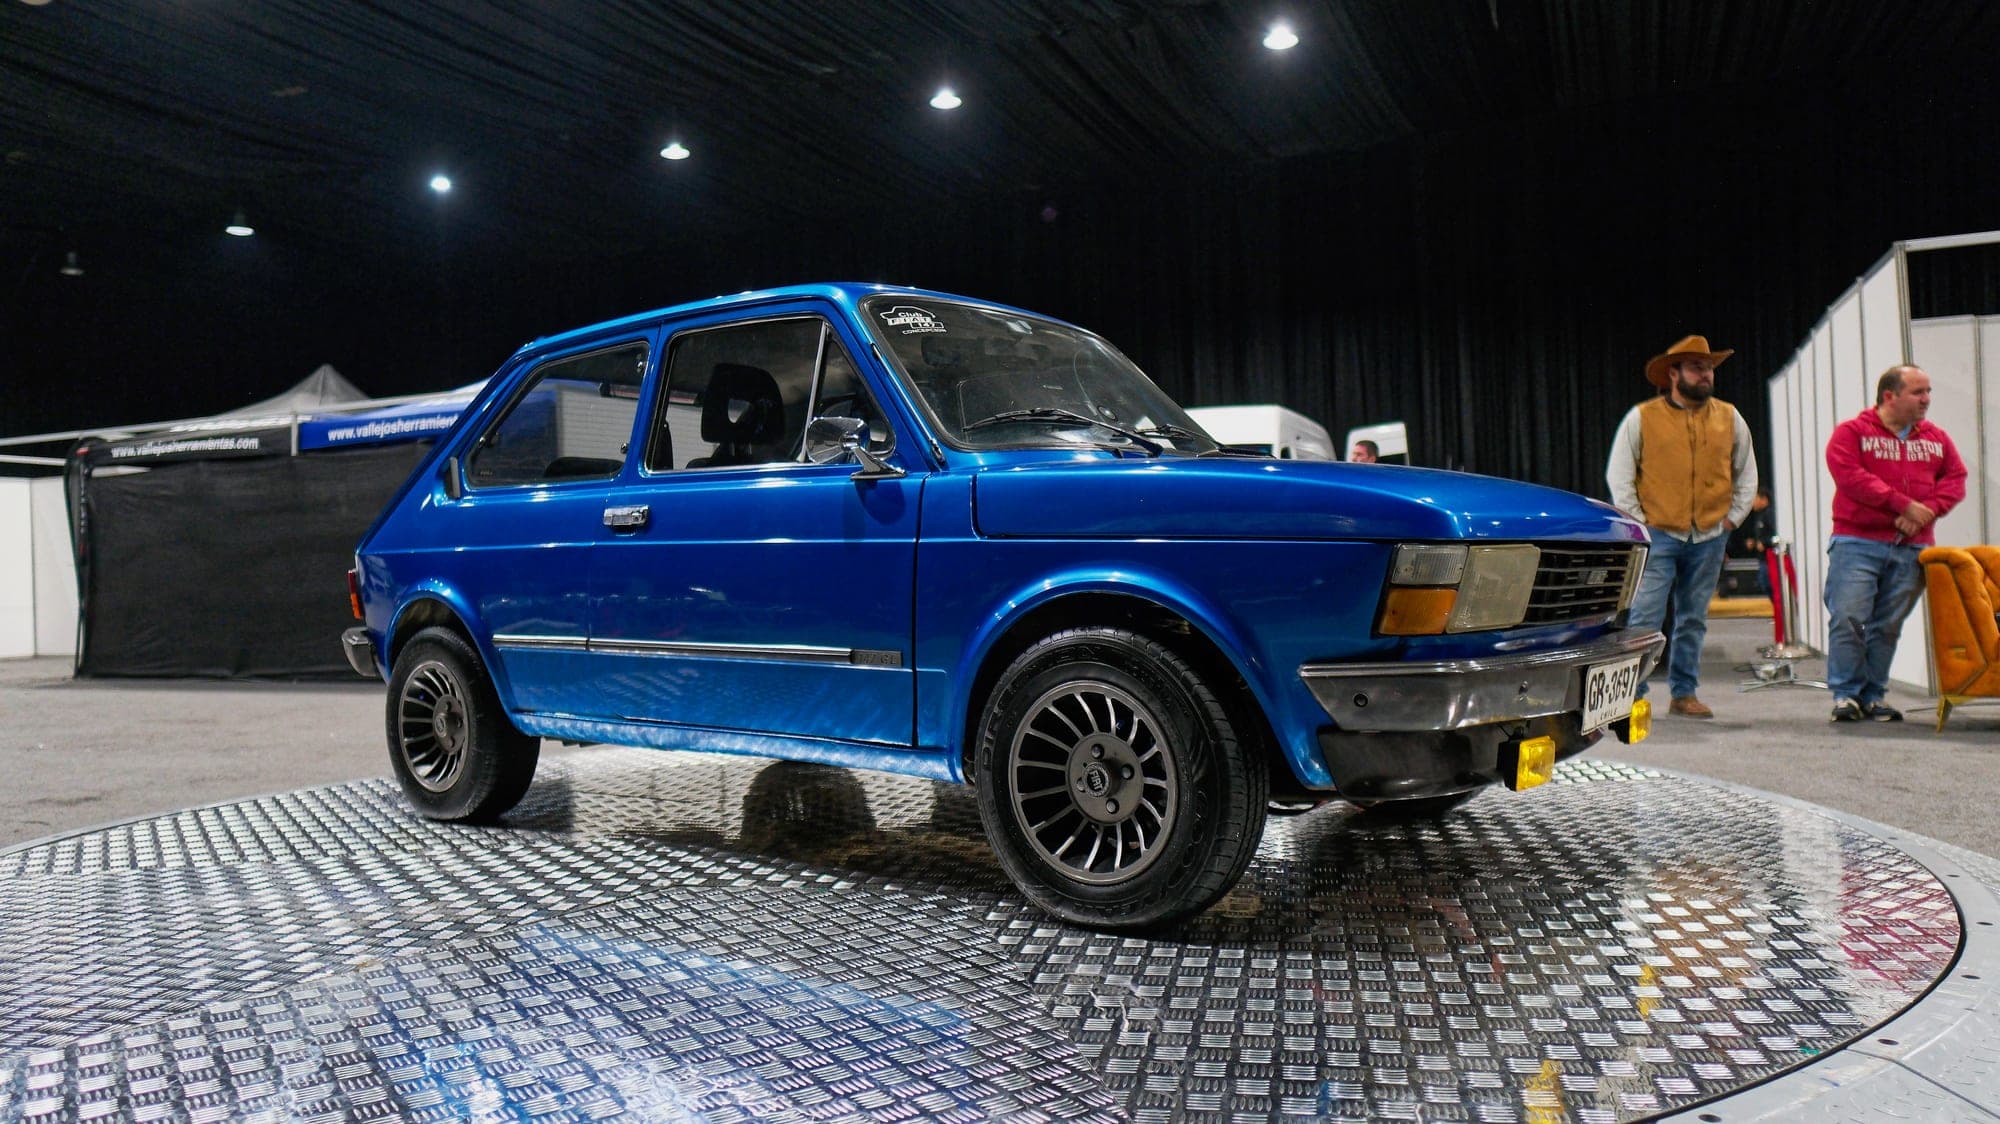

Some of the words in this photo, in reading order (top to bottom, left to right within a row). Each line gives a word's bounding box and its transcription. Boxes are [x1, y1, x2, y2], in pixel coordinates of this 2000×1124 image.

[111, 437, 259, 458] www.vallejosherramientas.com
[1861, 436, 1944, 459] WASHINGTON
[1600, 707, 1618, 721] CHILE
[1090, 769, 1103, 790] FIAT
